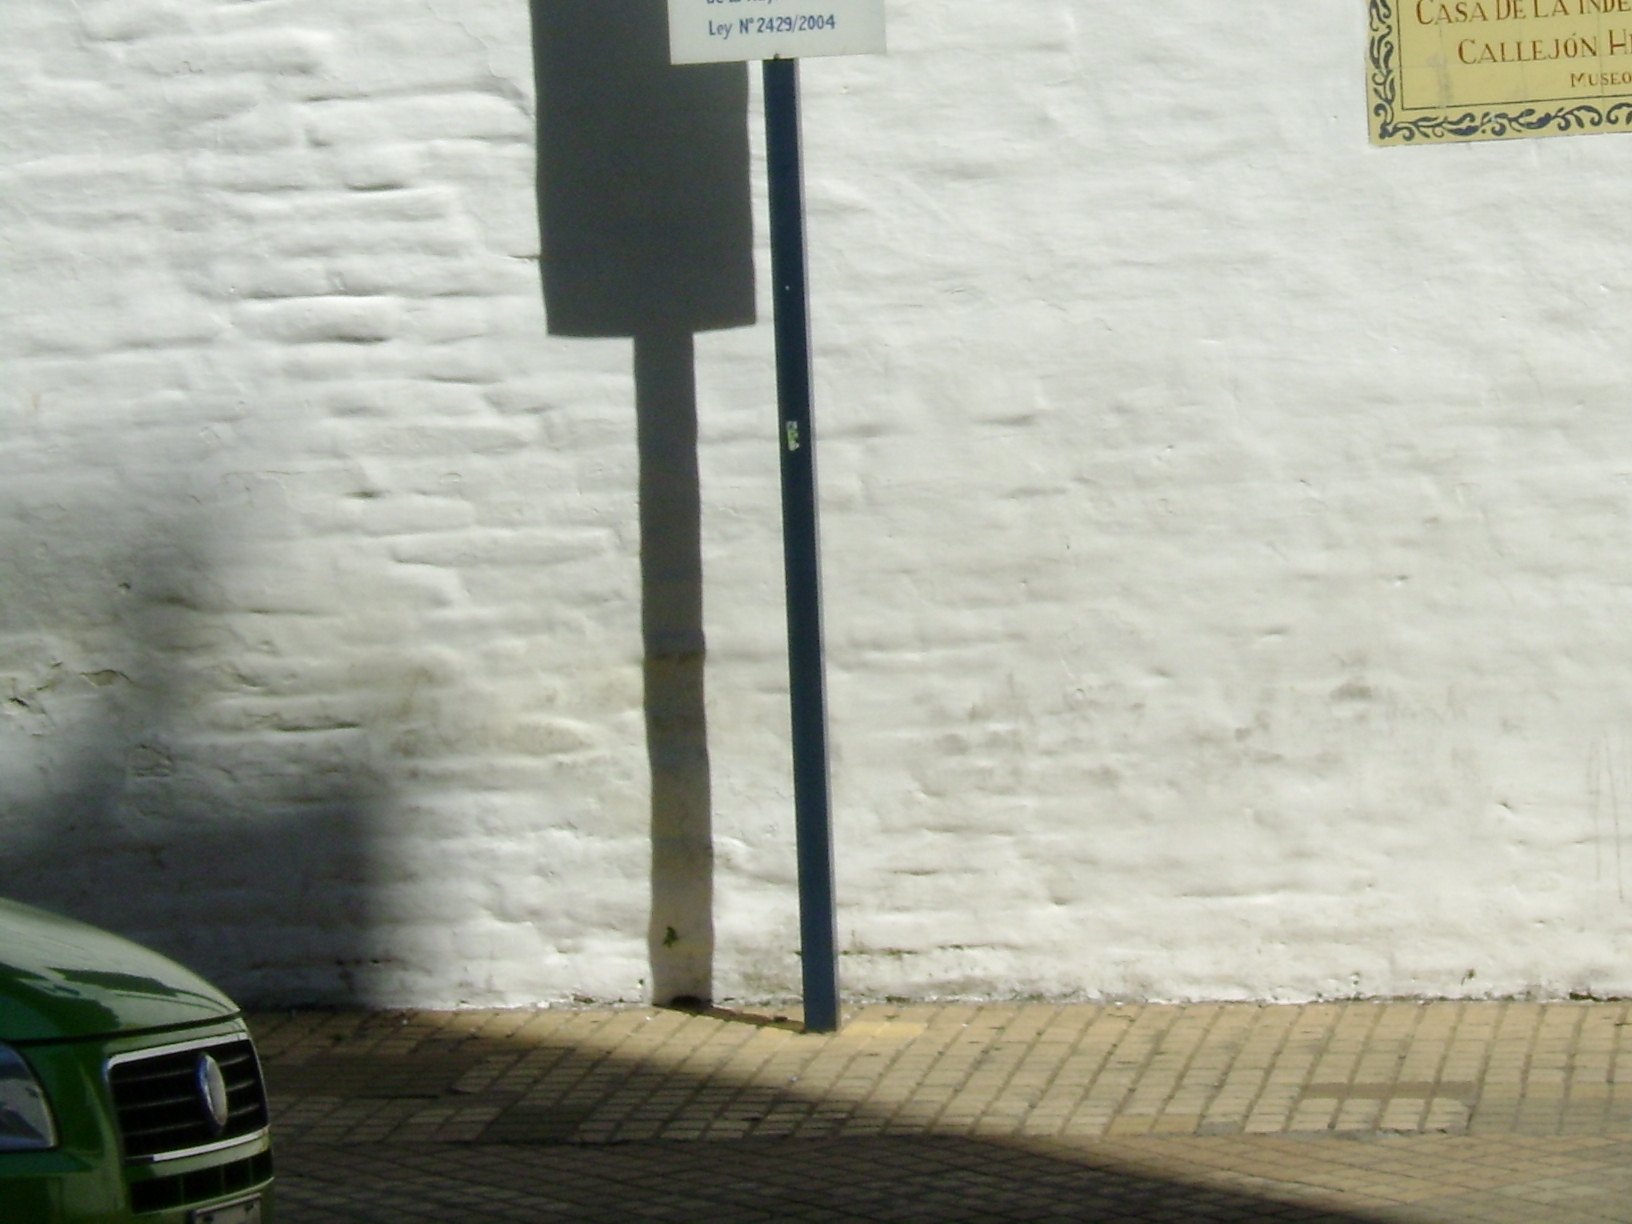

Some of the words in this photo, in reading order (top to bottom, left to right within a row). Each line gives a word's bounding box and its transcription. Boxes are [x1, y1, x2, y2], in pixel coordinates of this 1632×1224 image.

[708, 20, 732, 40] Ley
[1457, 31, 1598, 65] CALLEJÓN
[1570, 71, 1632, 88] MUSEO
